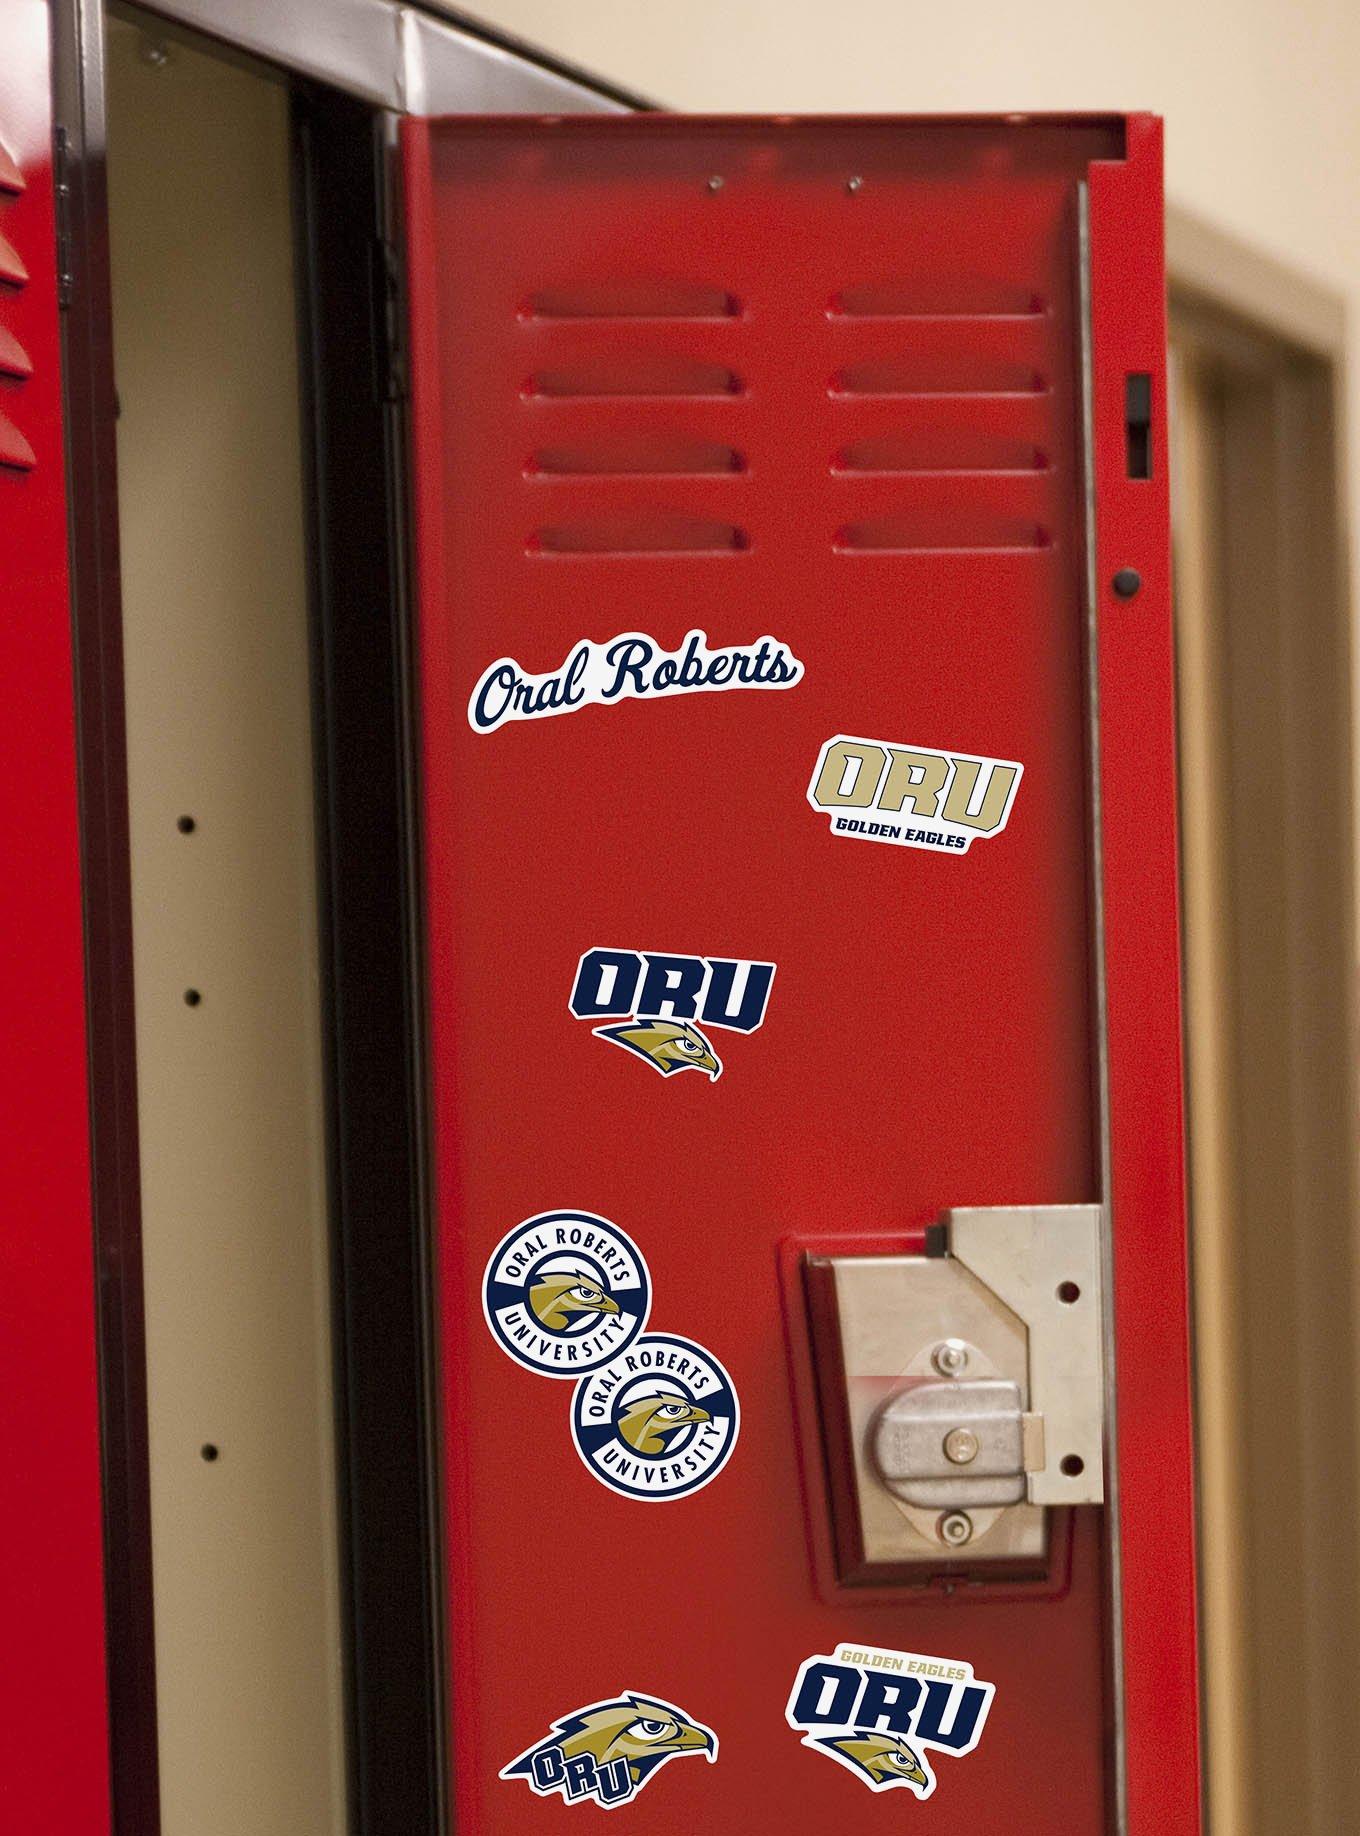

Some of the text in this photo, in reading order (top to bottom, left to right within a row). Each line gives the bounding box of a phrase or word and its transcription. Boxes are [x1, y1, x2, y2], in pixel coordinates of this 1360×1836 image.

[474, 636, 798, 728] Oral Roberts
[813, 740, 1018, 832] ORU
[836, 818, 967, 849] GOLDEN EAGLES
[571, 950, 774, 1032] ORU
[505, 1228, 630, 1281] ORAL ROBERTS
[505, 1311, 624, 1361] UNIVERSITY
[589, 1351, 709, 1417] ORAL ROBERTS
[603, 1424, 721, 1483] UNIVERSITY
[840, 1650, 966, 1680] GOLDEN EAGLES
[792, 1662, 987, 1750] ORU
[531, 1746, 634, 1804] ORU
